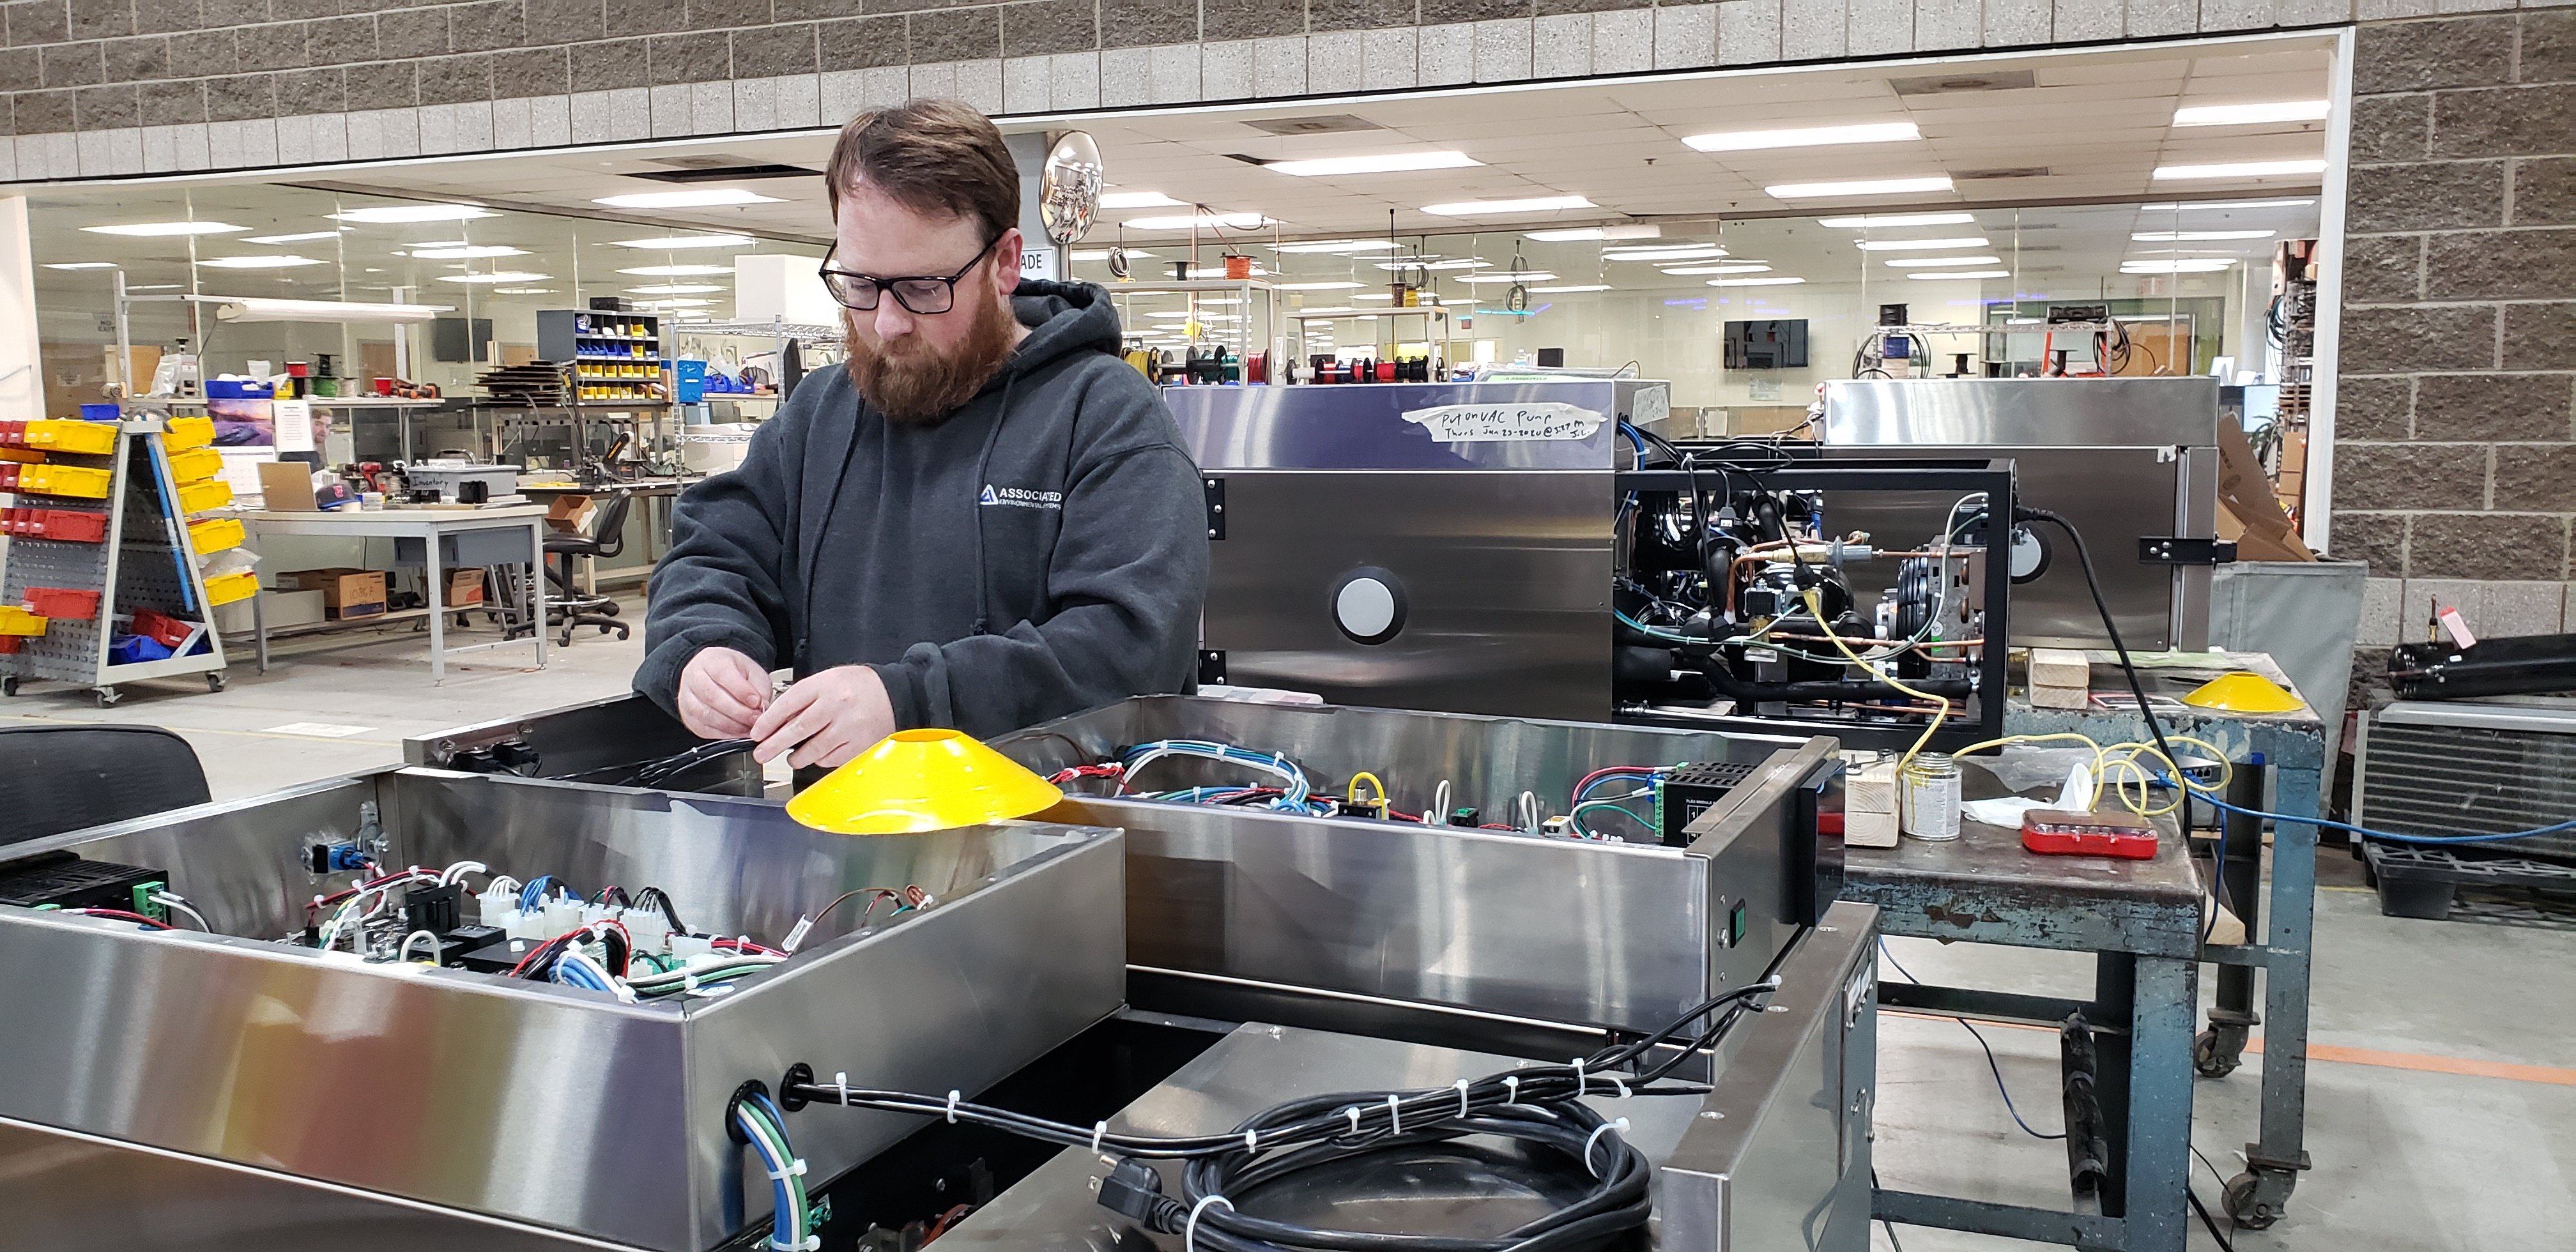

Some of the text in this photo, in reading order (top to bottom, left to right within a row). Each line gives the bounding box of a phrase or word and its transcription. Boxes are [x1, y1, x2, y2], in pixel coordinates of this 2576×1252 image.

[1480, 410, 1505, 423] VAC
[412, 476, 448, 488] Inventory
[999, 488, 1062, 502] ASSOCIATED
